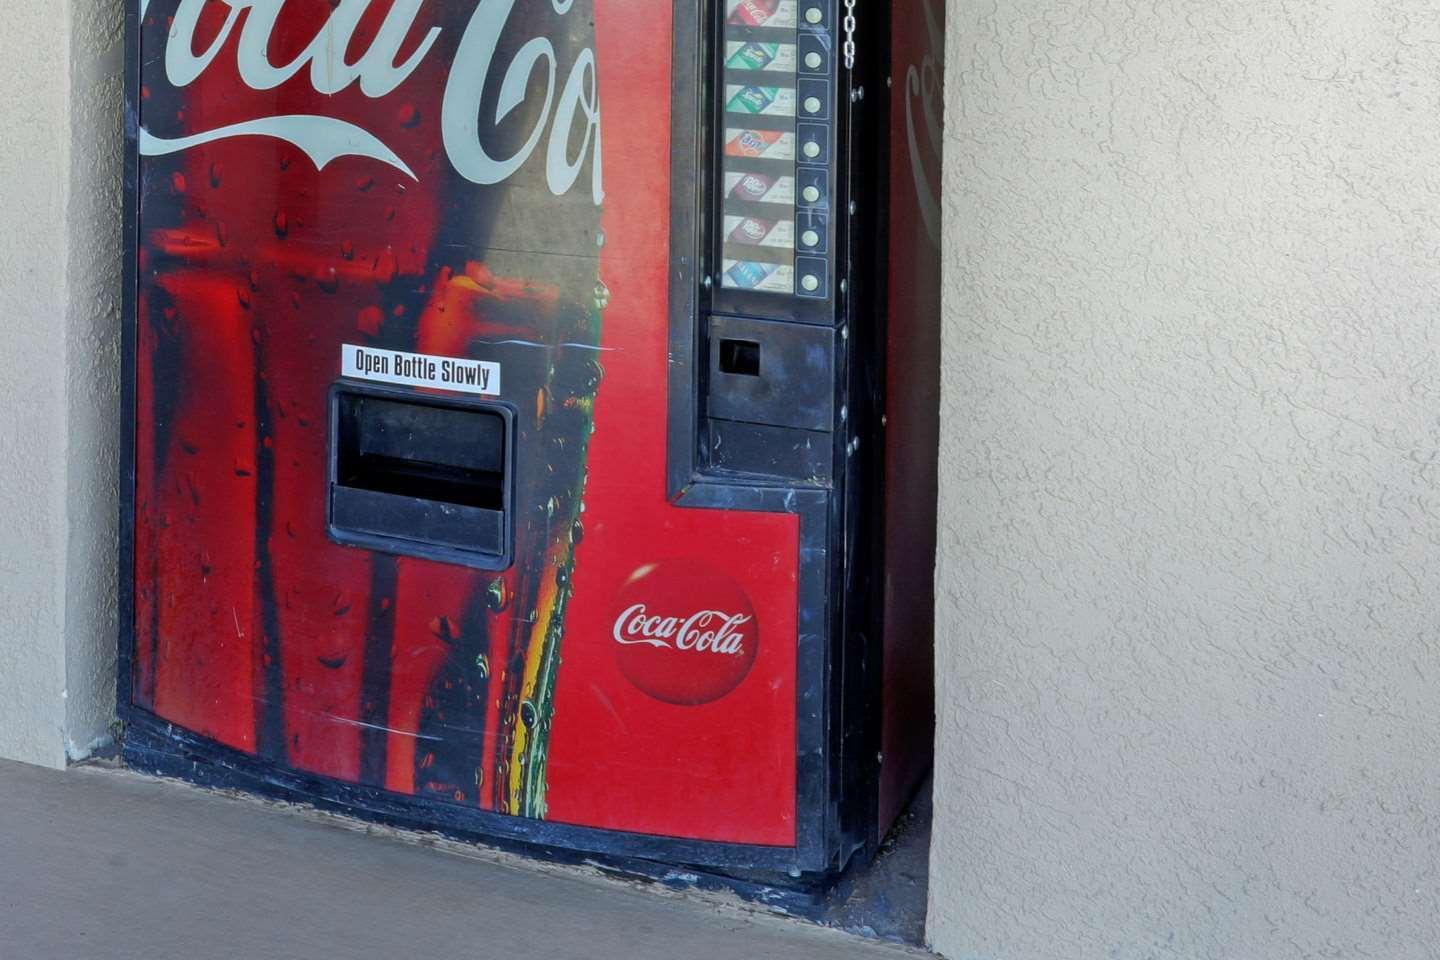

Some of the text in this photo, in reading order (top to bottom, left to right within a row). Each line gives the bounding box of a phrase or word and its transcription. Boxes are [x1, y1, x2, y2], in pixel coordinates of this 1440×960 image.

[355, 349, 490, 390] Open Bottle Slowly
[613, 603, 752, 654] Coca-Cola
